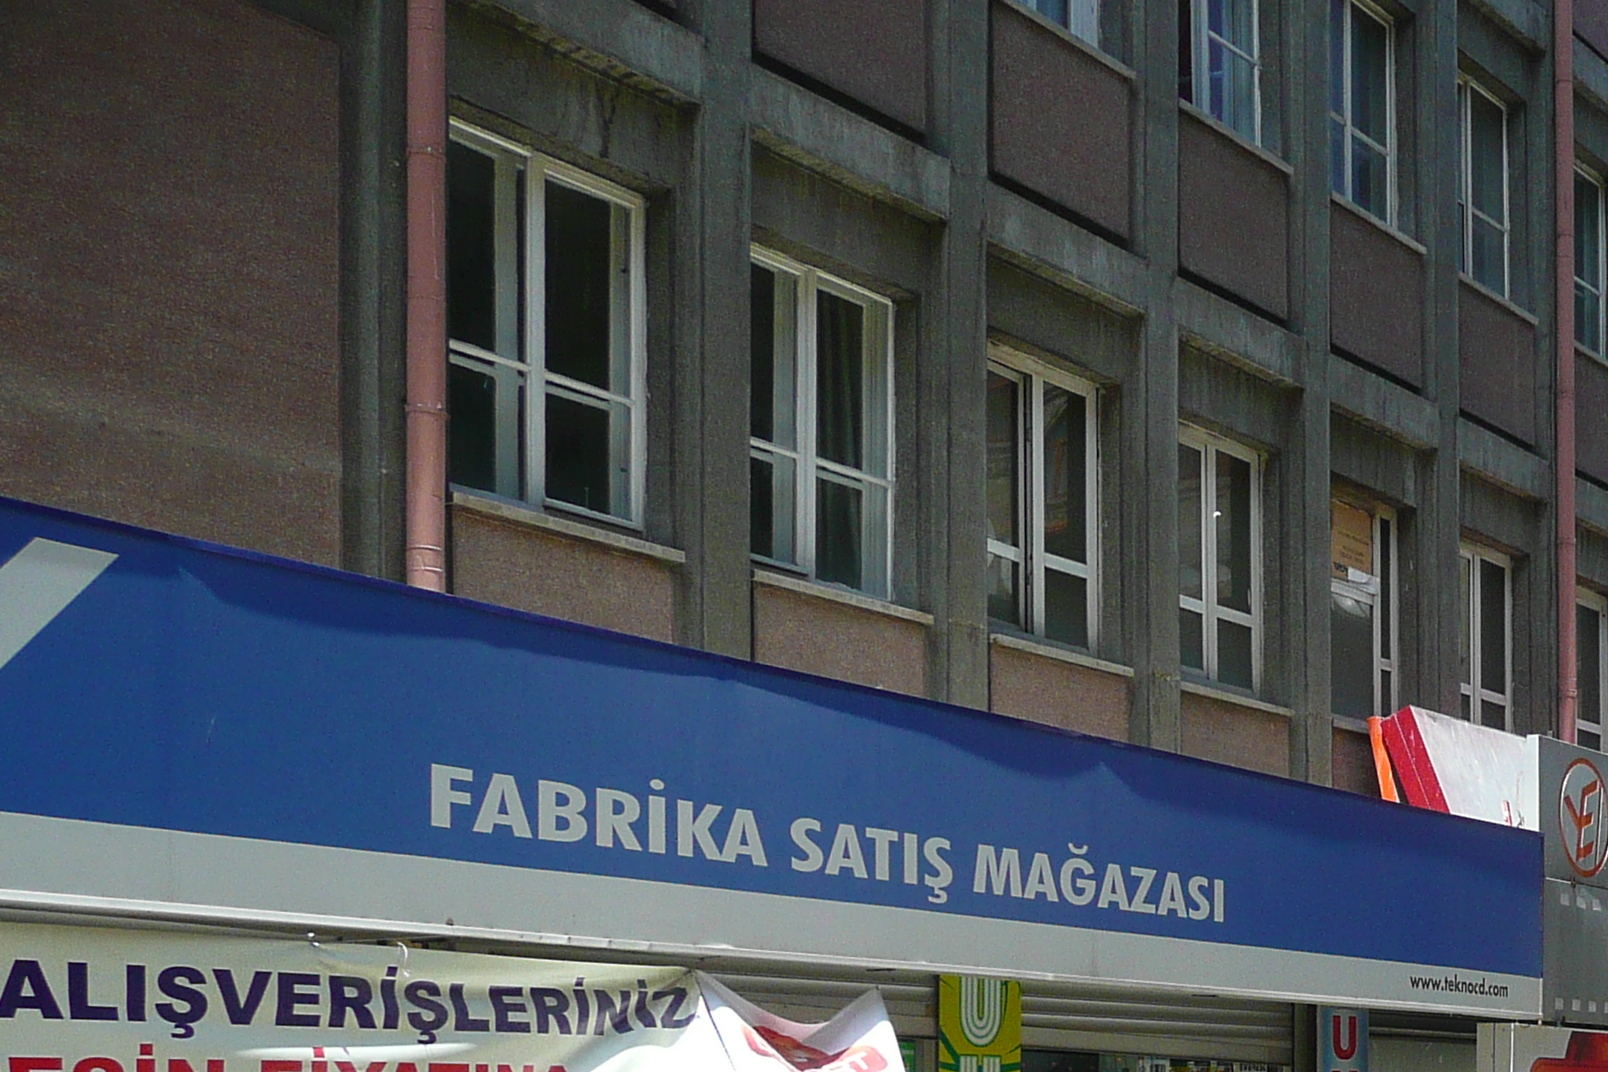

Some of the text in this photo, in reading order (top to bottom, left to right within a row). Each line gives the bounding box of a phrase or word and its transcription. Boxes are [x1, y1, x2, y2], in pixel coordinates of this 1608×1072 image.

[431, 762, 1227, 924] FABRİKA SATIŞ MAĞAZASI
[0, 959, 698, 1045] ALIŞVERİŞLERİNİZ
[1409, 973, 1509, 1000] www.teknocd.com
